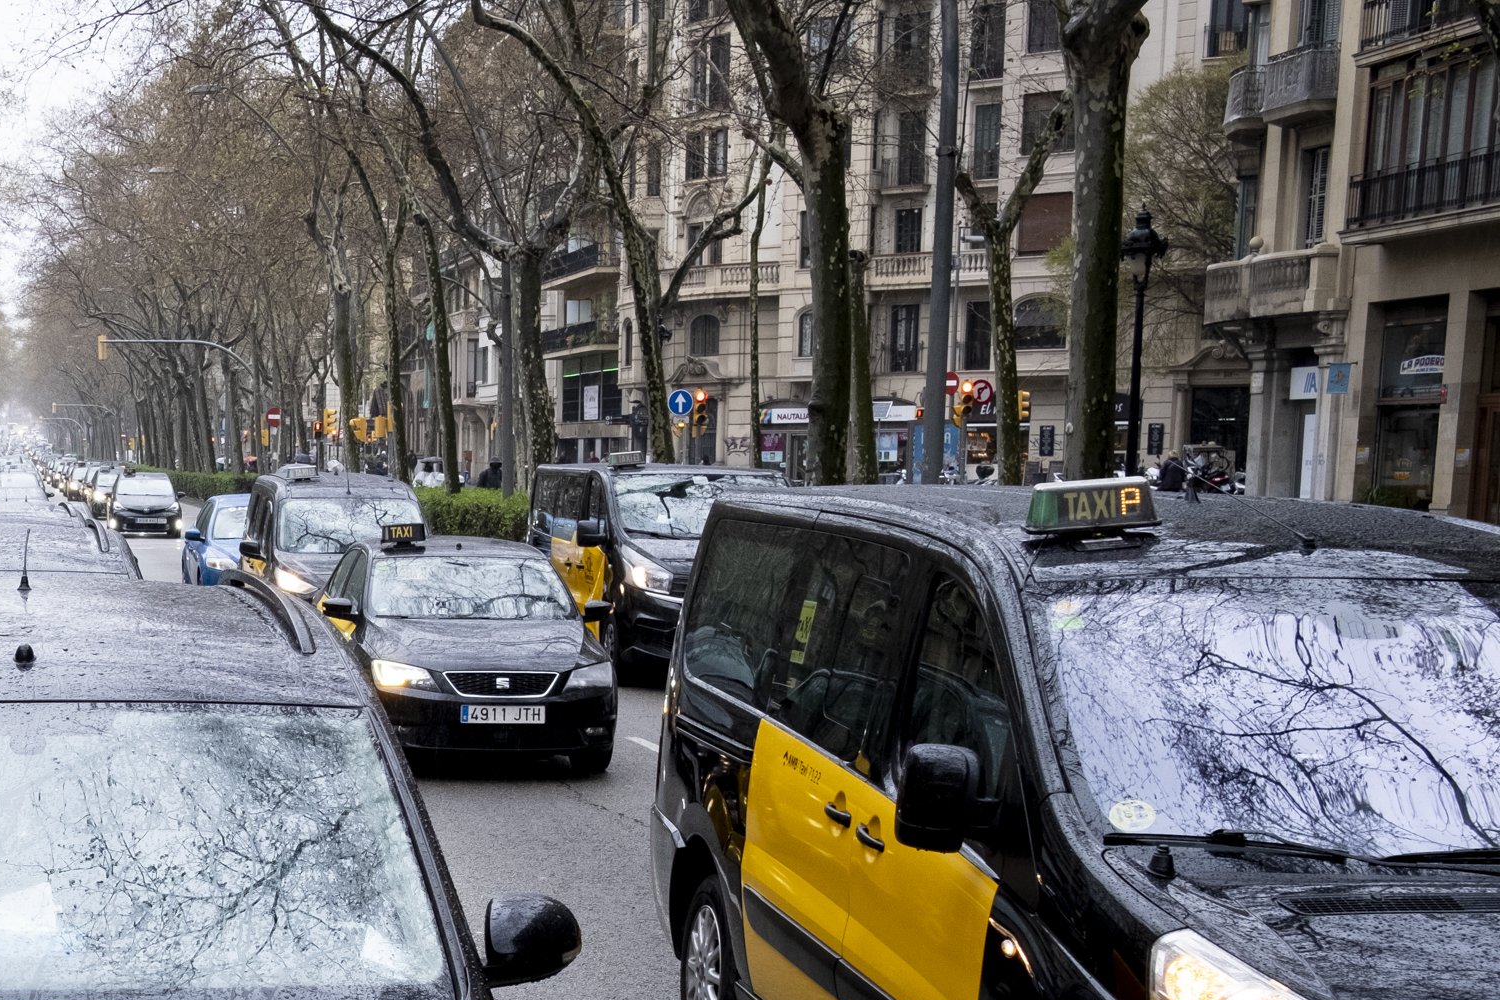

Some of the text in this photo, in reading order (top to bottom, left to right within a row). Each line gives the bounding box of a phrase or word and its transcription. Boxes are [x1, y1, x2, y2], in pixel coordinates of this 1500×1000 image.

[1063, 487, 1140, 521] TAXI P
[390, 526, 413, 538] TAXI
[470, 707, 506, 720] 4911
[513, 707, 541, 721] JTH
